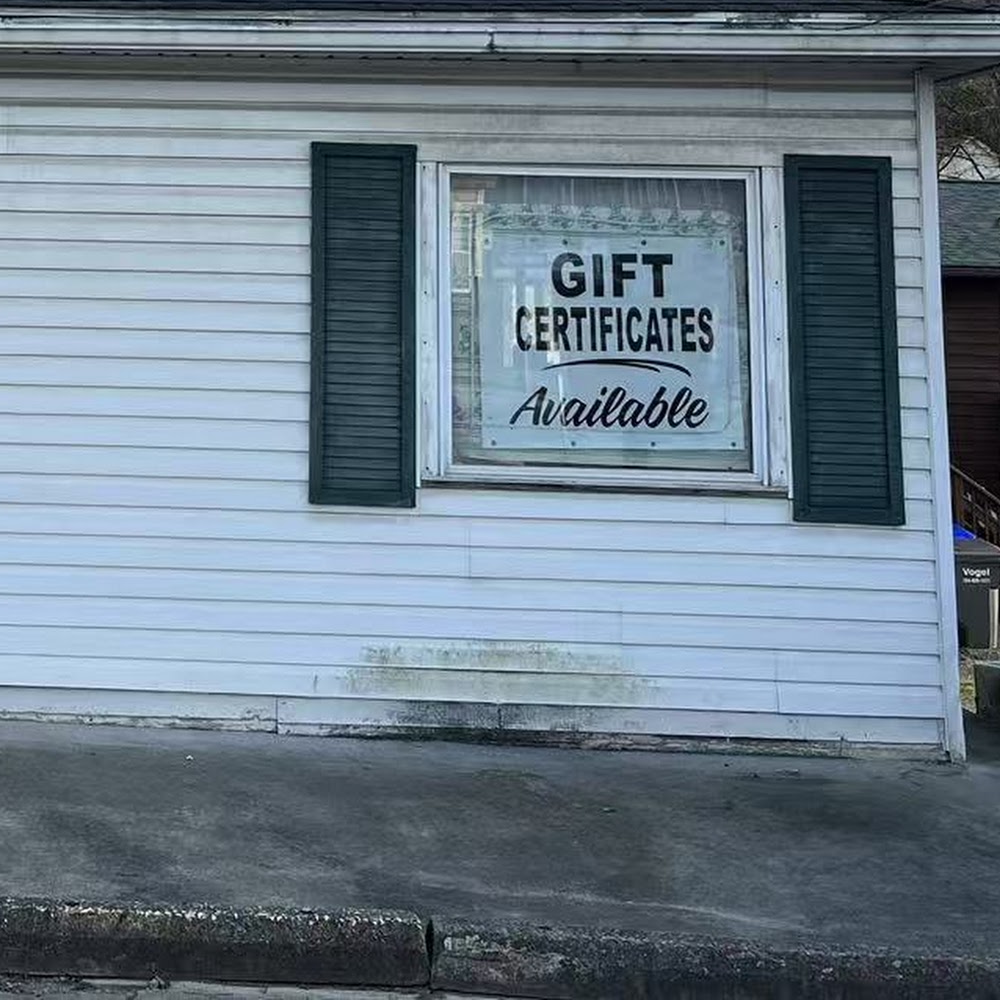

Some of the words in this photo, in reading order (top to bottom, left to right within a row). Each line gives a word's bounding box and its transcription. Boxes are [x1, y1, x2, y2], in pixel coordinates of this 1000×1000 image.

[551, 251, 674, 299] GIFT
[515, 305, 715, 352] CERTIFICATES
[509, 385, 711, 429] Available
[961, 567, 990, 578] Vogel
